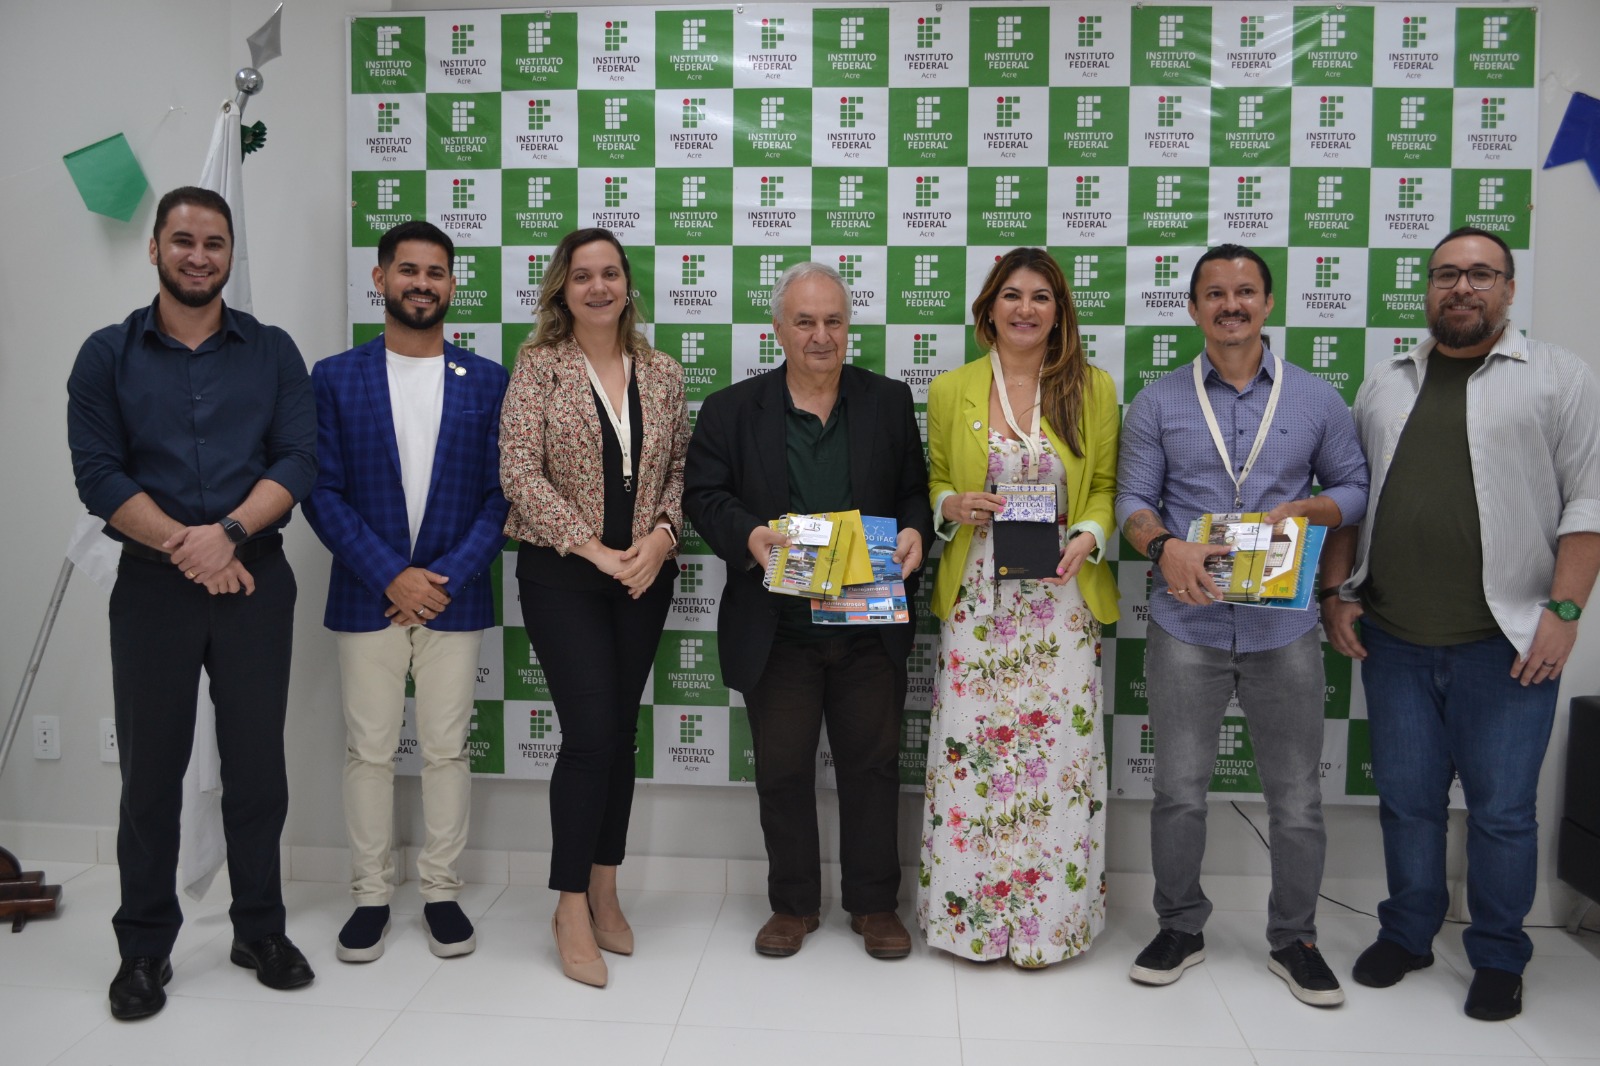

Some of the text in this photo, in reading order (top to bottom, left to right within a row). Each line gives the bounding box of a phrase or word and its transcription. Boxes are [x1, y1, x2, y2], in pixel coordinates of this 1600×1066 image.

[670, 55, 718, 63] INSTITUTO
[749, 54, 797, 63] INSTITUTO
[828, 54, 876, 62] INSTITUTO
[905, 54, 953, 62] INSTITUTO
[985, 52, 1033, 61] INSTITUTO
[1065, 52, 1114, 61] INSTITUTO
[1146, 52, 1196, 60] INSTITUTO
[1227, 52, 1276, 61] INSTITUTO
[1307, 52, 1357, 60] INSTITUTO
[1389, 54, 1438, 62] INSTITUTO
[1470, 54, 1519, 62] INSTITUTO
[516, 58, 563, 66] INSTITUTO
[593, 56, 640, 65] INSTITUTO
[1150, 60, 1191, 68] FEDERAL
[1312, 60, 1352, 68] FEDERAL
[674, 63, 714, 71] FEDERAL
[753, 63, 793, 71] FEDERAL
[832, 62, 872, 70] FEDERAL
[909, 62, 949, 70] FEDERAL
[989, 61, 1029, 69] FEDERAL
[1069, 61, 1110, 69] FEDERAL
[1231, 61, 1271, 69] FEDERAL
[1393, 62, 1433, 70] FEDERAL
[1474, 62, 1514, 70] FEDERAL
[828, 132, 875, 141] INSTITUTO
[984, 132, 1032, 141] INSTITUTO
[1145, 132, 1194, 141] INSTITUTO
[1307, 132, 1355, 141] INSTITUTO
[1468, 134, 1517, 143] INSTITUTO
[988, 141, 1028, 149] FEDERAL
[1149, 141, 1189, 149] FEDERAL
[1472, 143, 1512, 151] FEDERAL
[670, 212, 717, 220] INSTITUTO
[748, 212, 795, 220] INSTITUTO
[903, 212, 951, 220] INSTITUTO
[1063, 212, 1111, 220] INSTITUTO
[1224, 212, 1273, 221] INSTITUTO
[1385, 214, 1434, 222] INSTITUTO
[1466, 214, 1515, 223] INSTITUTO
[907, 220, 947, 228] FEDERAL
[1067, 220, 1107, 228] FEDERAL
[1228, 221, 1268, 229] FEDERAL
[1389, 222, 1429, 230] FEDERAL
[670, 290, 717, 299] INSTITUTO
[902, 290, 950, 299] INSTITUTO
[1141, 291, 1191, 300] INSTITUTO
[1302, 292, 1351, 301] INSTITUTO
[1382, 294, 1425, 302] INSTITUT
[906, 299, 946, 307] FEDERAL
[1145, 299, 1186, 307] FEDERAL
[1306, 301, 1346, 309] FEDERAL
